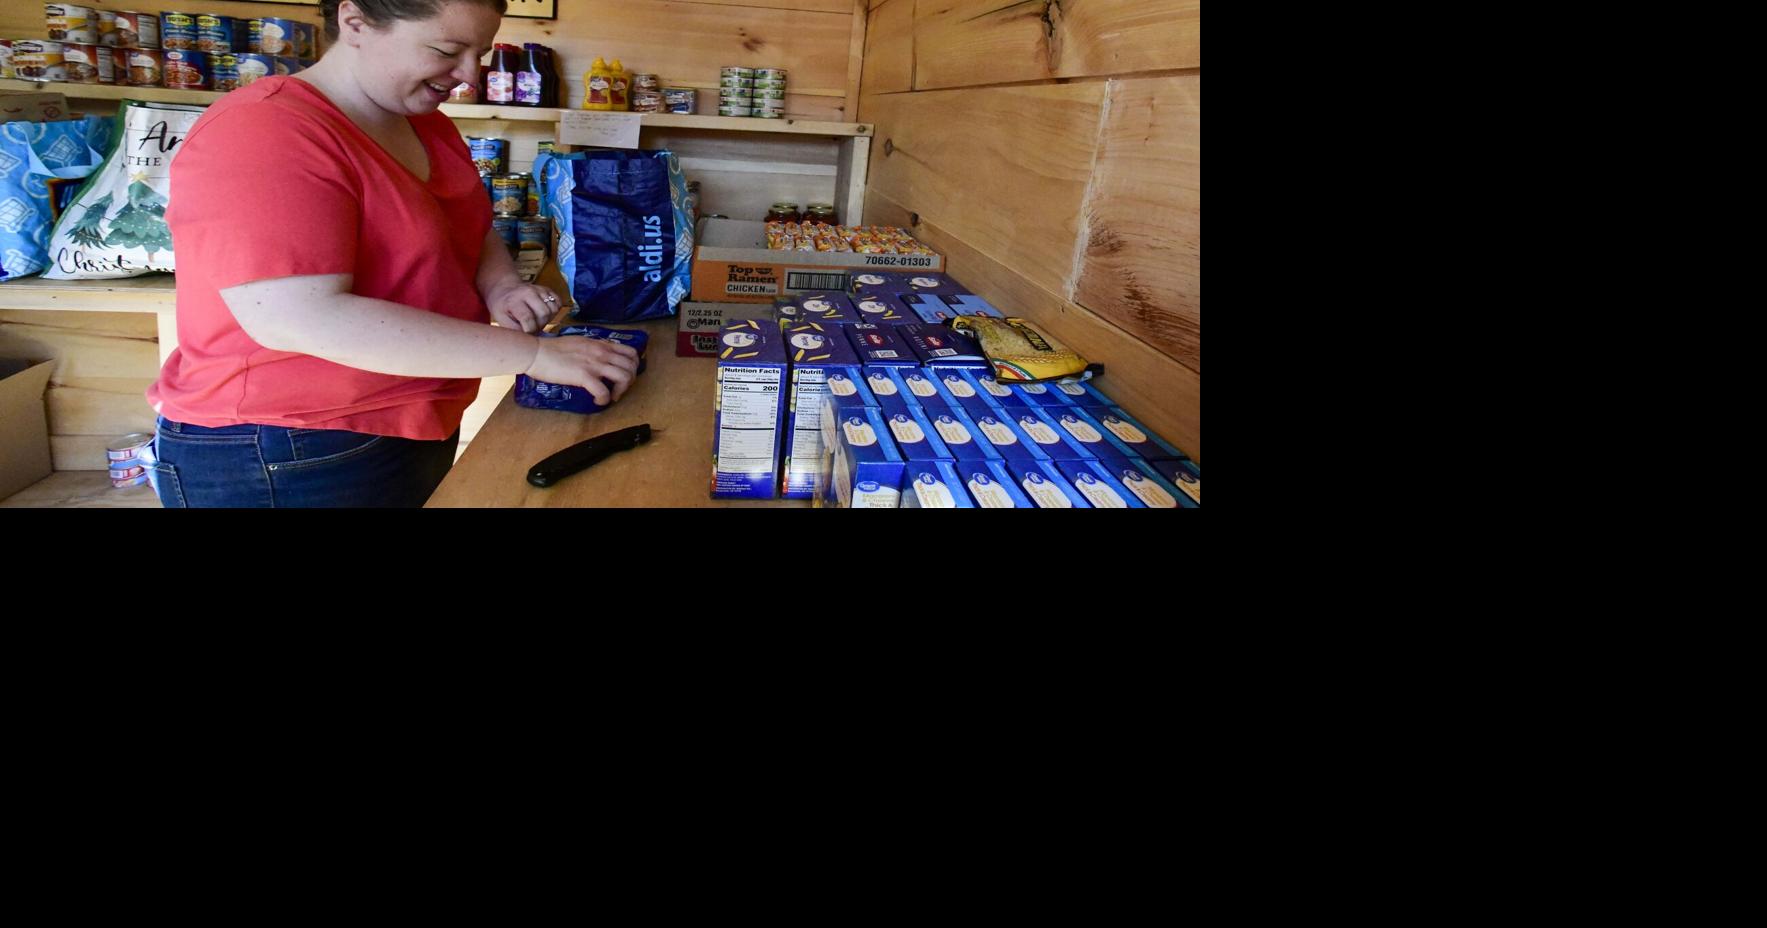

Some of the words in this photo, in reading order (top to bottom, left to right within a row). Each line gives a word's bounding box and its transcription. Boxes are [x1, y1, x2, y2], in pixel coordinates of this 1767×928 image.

[128, 156, 162, 166] THE
[637, 215, 663, 283] aldi.us
[865, 256, 931, 266] 70662-01303
[728, 265, 753, 276] Top
[728, 273, 777, 283] Ramen
[727, 284, 766, 293] CHICKEN
